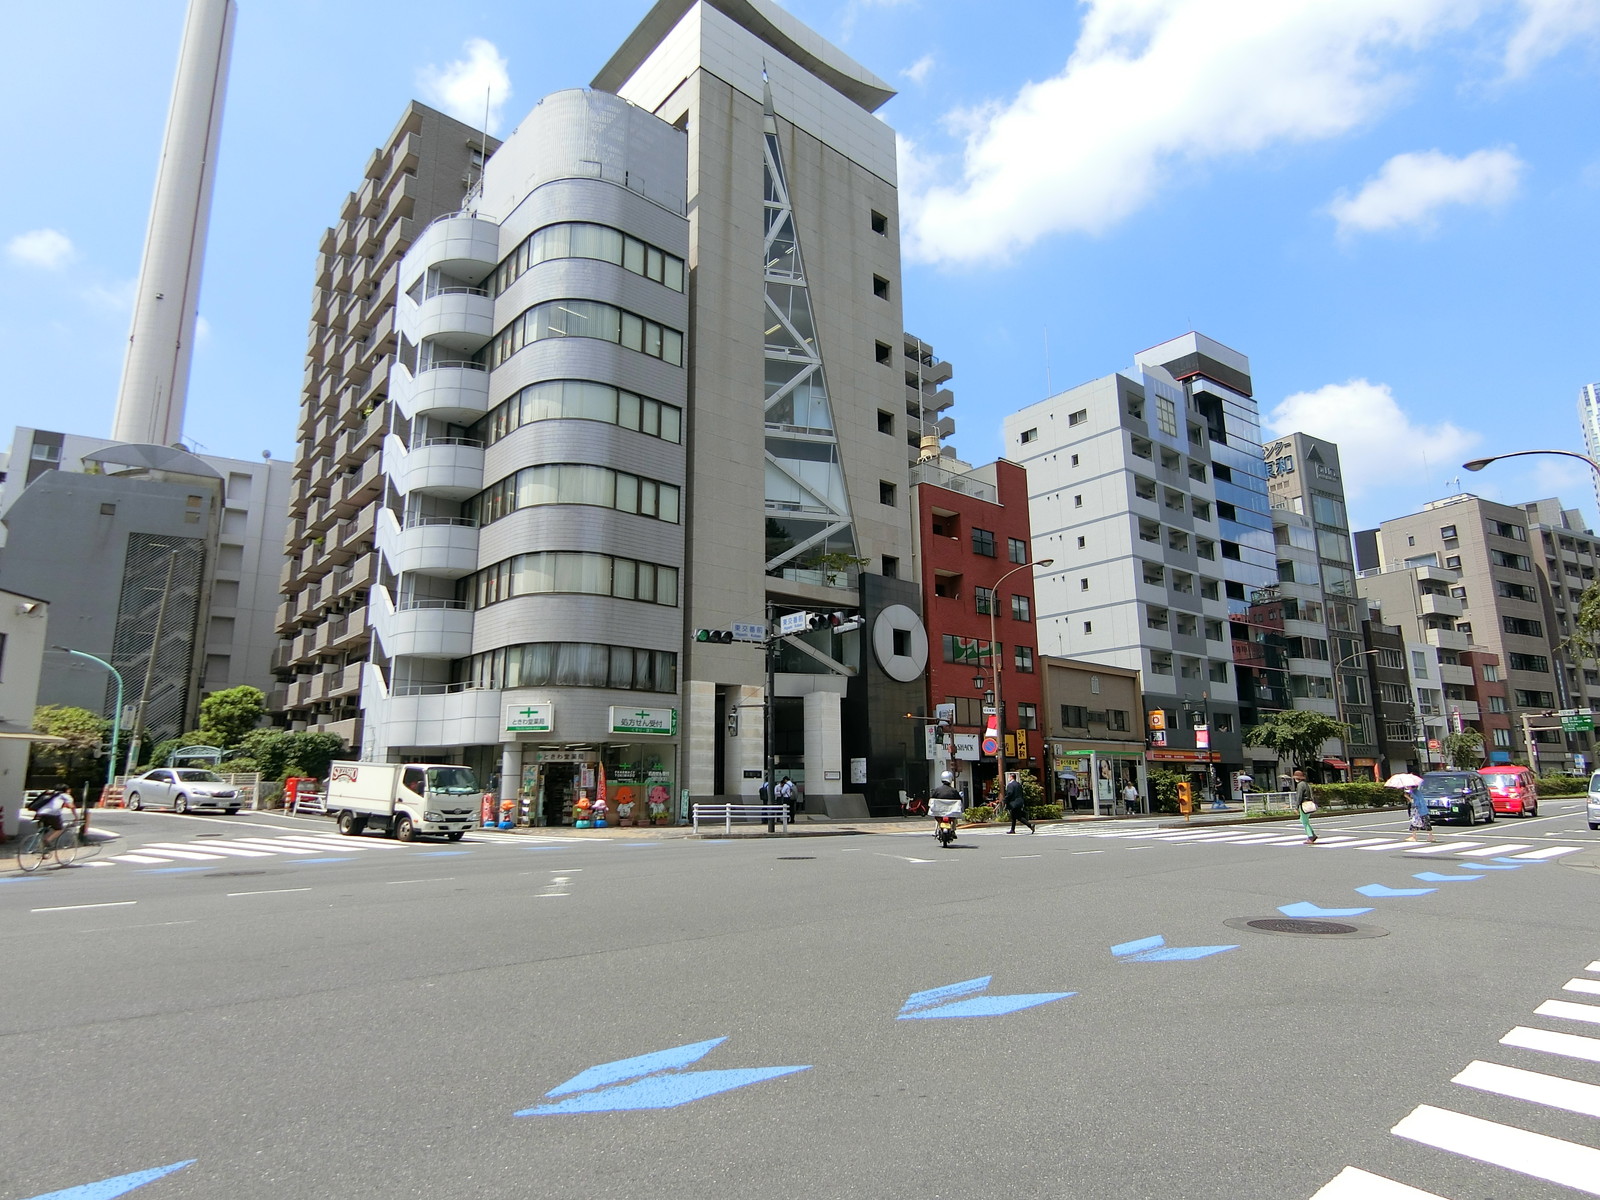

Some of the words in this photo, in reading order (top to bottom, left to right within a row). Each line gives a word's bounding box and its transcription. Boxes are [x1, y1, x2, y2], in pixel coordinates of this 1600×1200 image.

[783, 615, 804, 625] 東交番前
[735, 624, 763, 634] 東交番前
[621, 718, 663, 728] 処方せん受付
